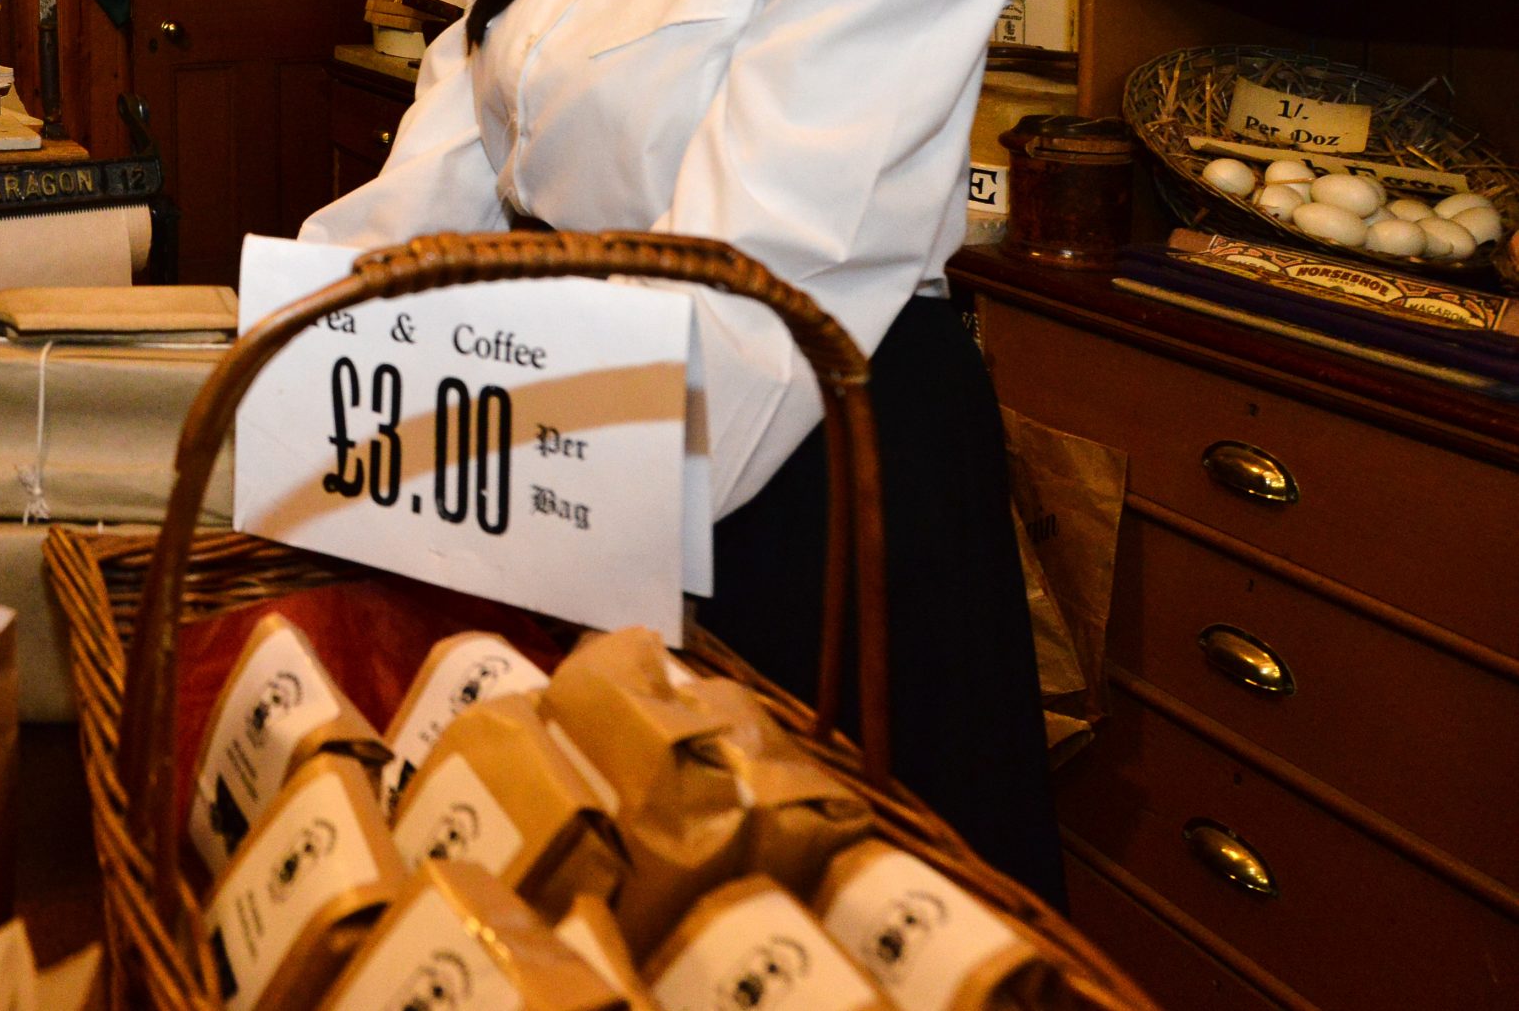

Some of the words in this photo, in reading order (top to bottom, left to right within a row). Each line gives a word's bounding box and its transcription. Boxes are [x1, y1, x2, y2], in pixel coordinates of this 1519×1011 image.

[1244, 115, 1280, 137] Per
[1291, 128, 1341, 146] Doz
[120, 168, 146, 194] 12
[1295, 266, 1389, 298] HORSESHOE
[391, 311, 416, 344] &
[453, 323, 548, 371] Coffee
[324, 356, 512, 535] £3.00
[535, 423, 589, 462] Per
[530, 484, 591, 530] Bag
